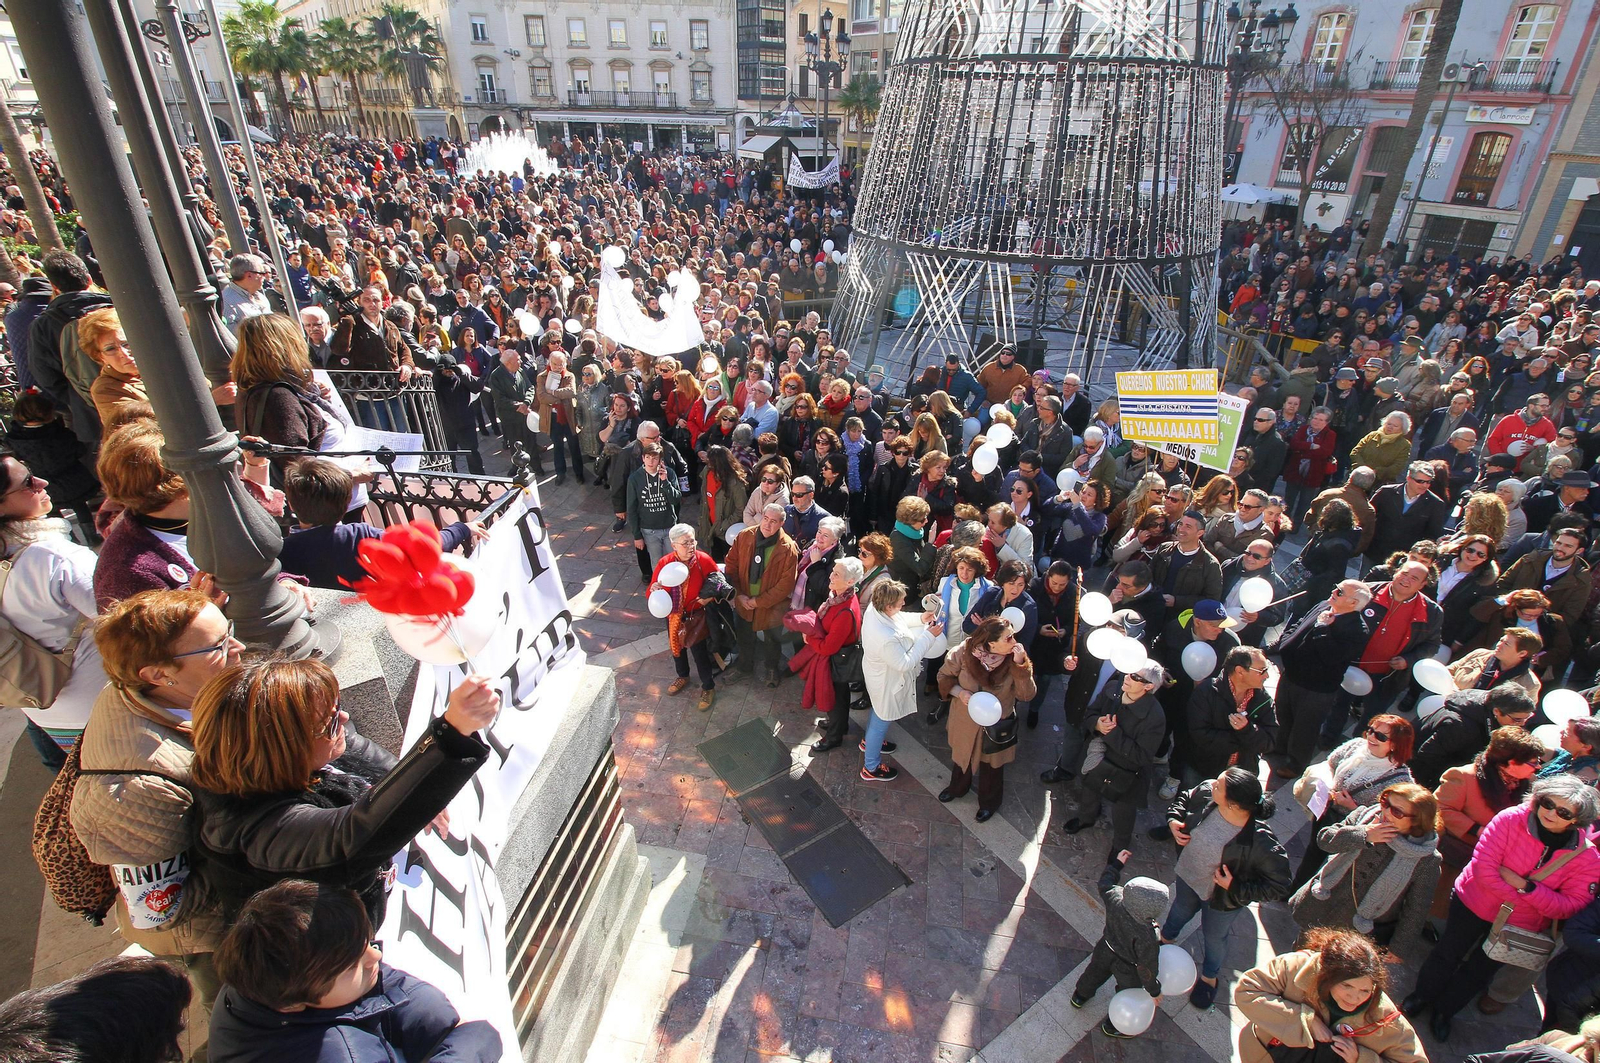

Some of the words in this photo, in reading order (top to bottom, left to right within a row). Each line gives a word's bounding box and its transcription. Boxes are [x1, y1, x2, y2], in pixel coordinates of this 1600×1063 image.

[1315, 164, 1329, 178] SE
[1323, 180, 1331, 190] 14
[1329, 181, 1338, 191] 20
[1119, 375, 1153, 391] QUEREMOS
[1155, 374, 1188, 391] NUESTRO
[1190, 373, 1215, 391] CHARE
[1136, 403, 1154, 412] ISLA
[1154, 404, 1192, 413] CRISTINA
[1165, 442, 1197, 460] MEDIOS
[122, 851, 189, 887] ANIZA
